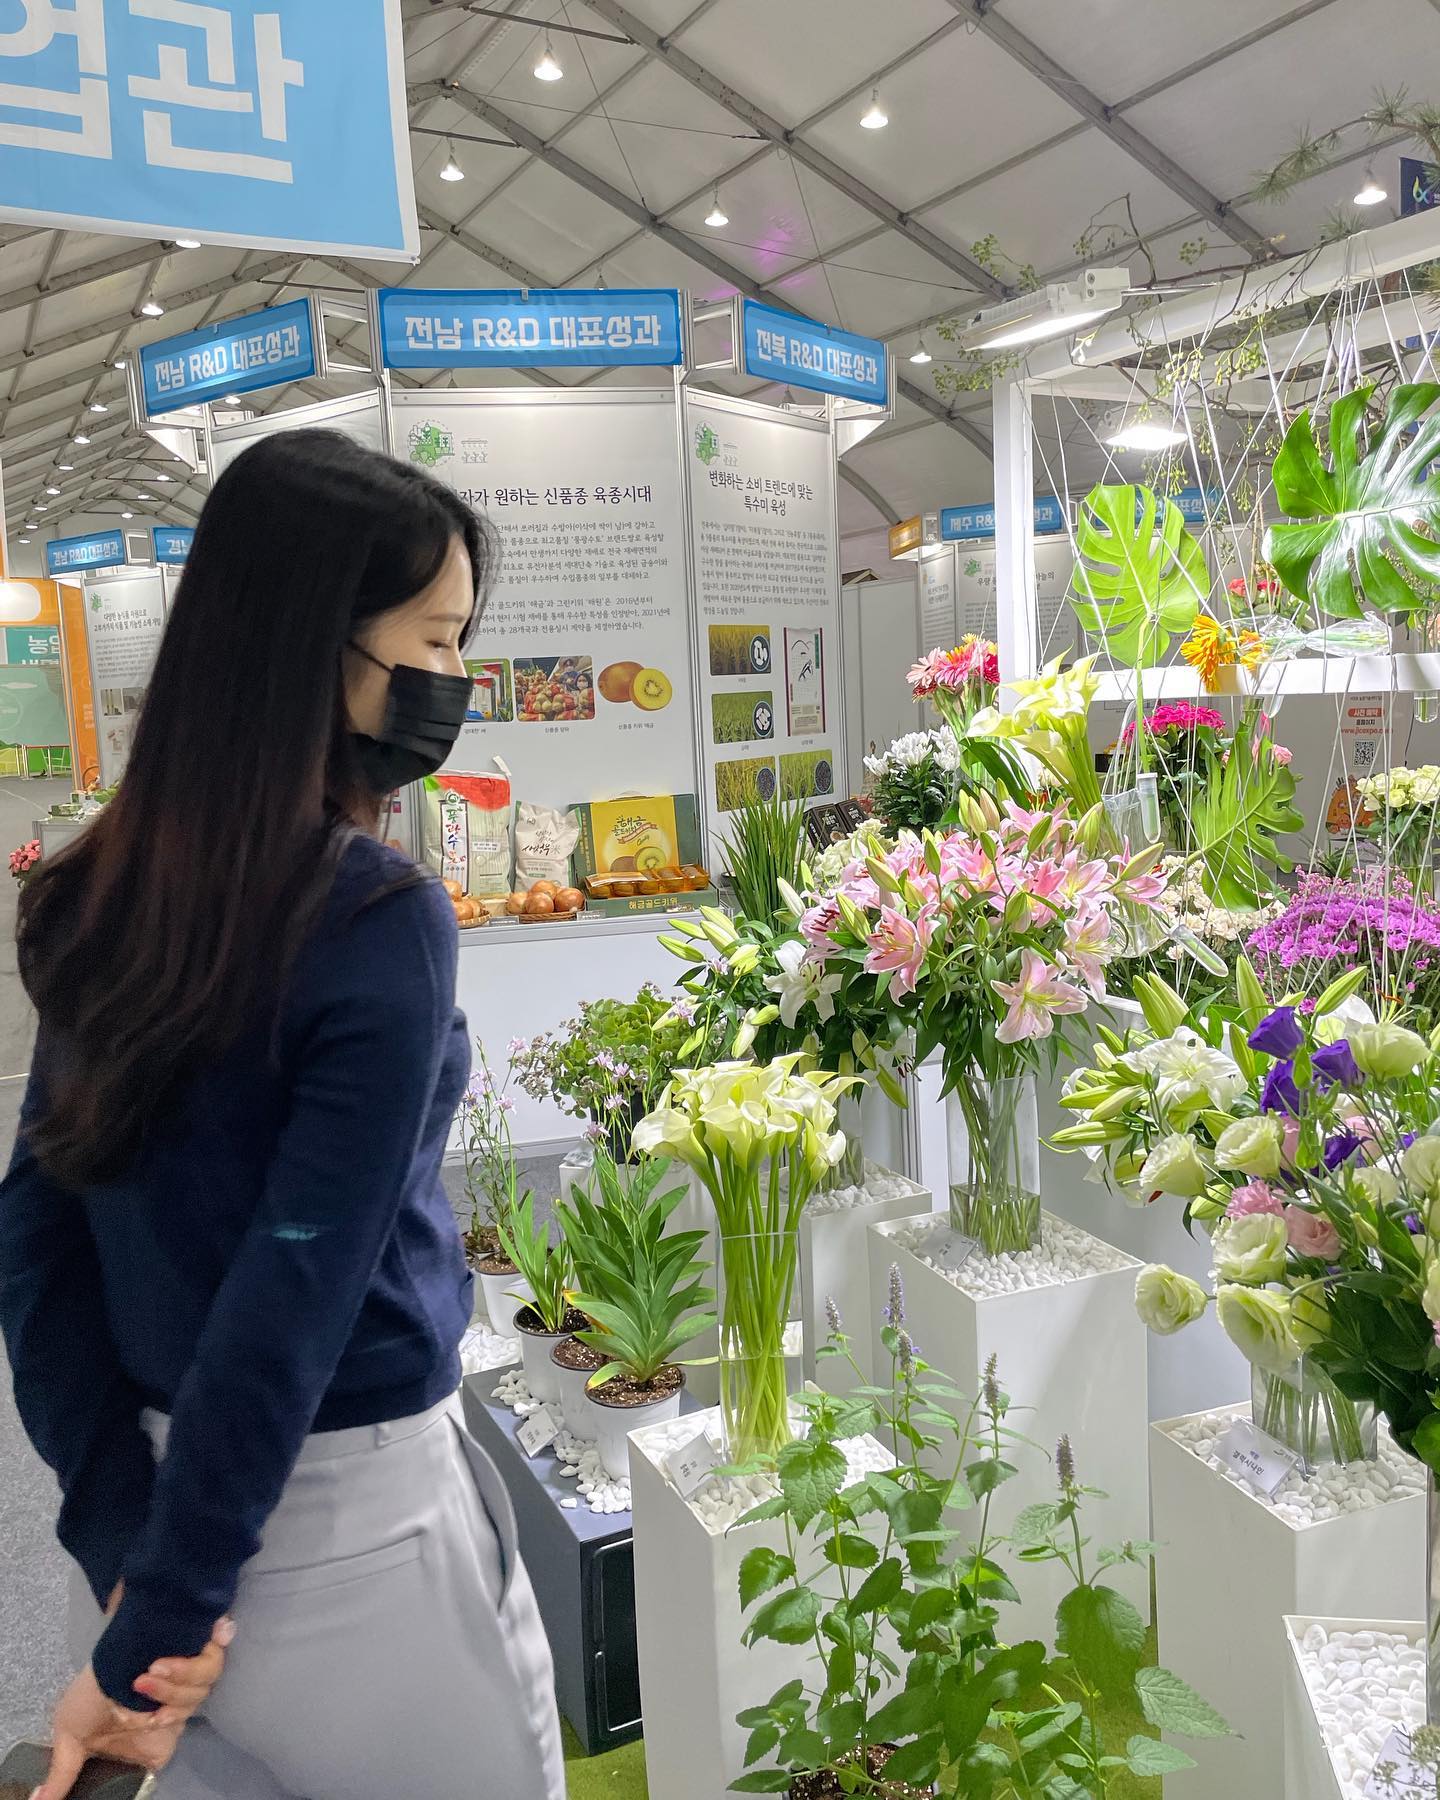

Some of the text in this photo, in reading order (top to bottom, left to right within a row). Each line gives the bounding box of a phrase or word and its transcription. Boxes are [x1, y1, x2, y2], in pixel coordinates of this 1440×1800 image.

[405, 314, 662, 350] 전남 R&D 대표성과
[154, 325, 301, 393] 전남 R&D 대표성과
[756, 328, 878, 385] 전북 R&D 대표성과
[456, 484, 652, 507] 자가 원하는 신품종 육종시대
[709, 470, 814, 501] 변화하는 소비 트렌드에 맞는
[744, 496, 787, 517] 특수미 육성
[975, 513, 995, 528] R&
[628, 897, 678, 911] 해금골드키위
